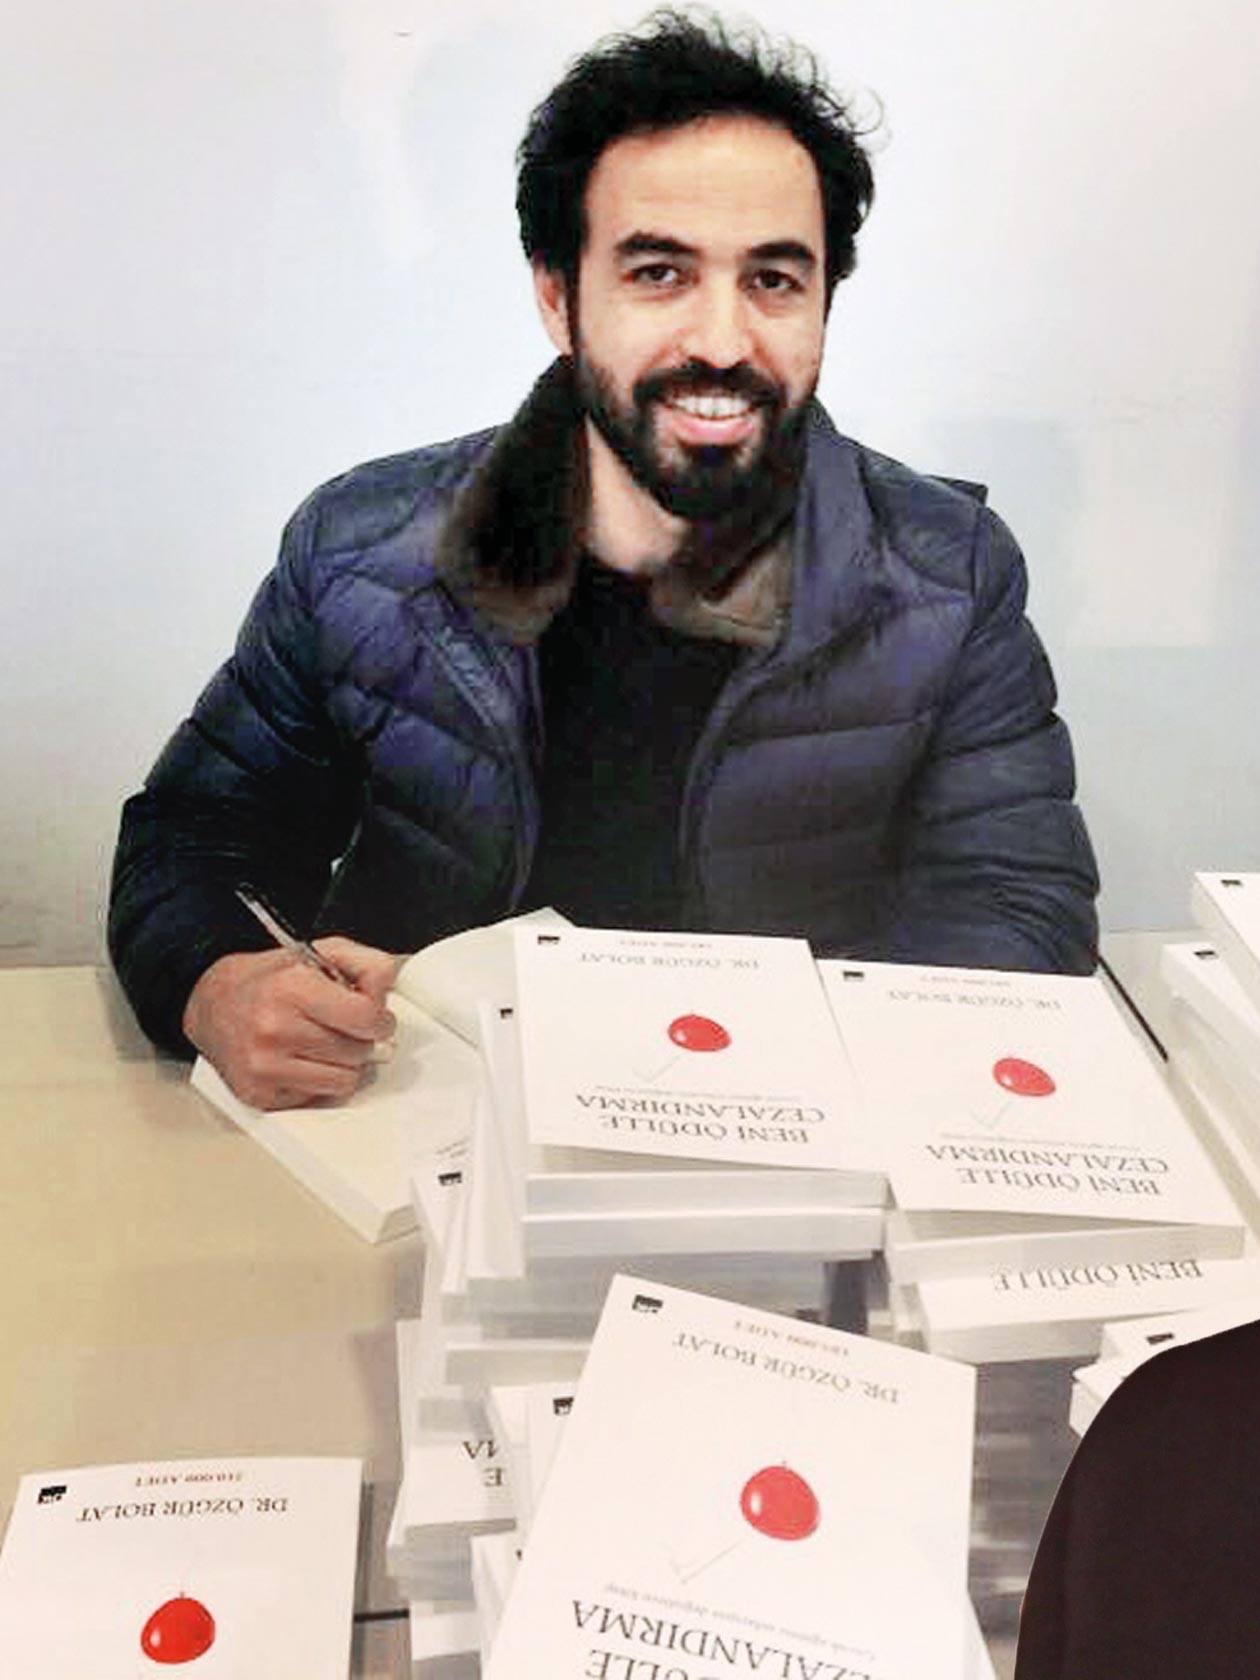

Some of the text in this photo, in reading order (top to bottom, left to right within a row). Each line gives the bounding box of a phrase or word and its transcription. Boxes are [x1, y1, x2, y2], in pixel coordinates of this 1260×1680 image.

[575, 1094, 826, 1123] CEZALANDIRMA
[925, 1144, 1169, 1173] CEZALANDIRMA
[673, 1332, 757, 1367] BOLAT
[77, 1503, 157, 1523] BOLAT
